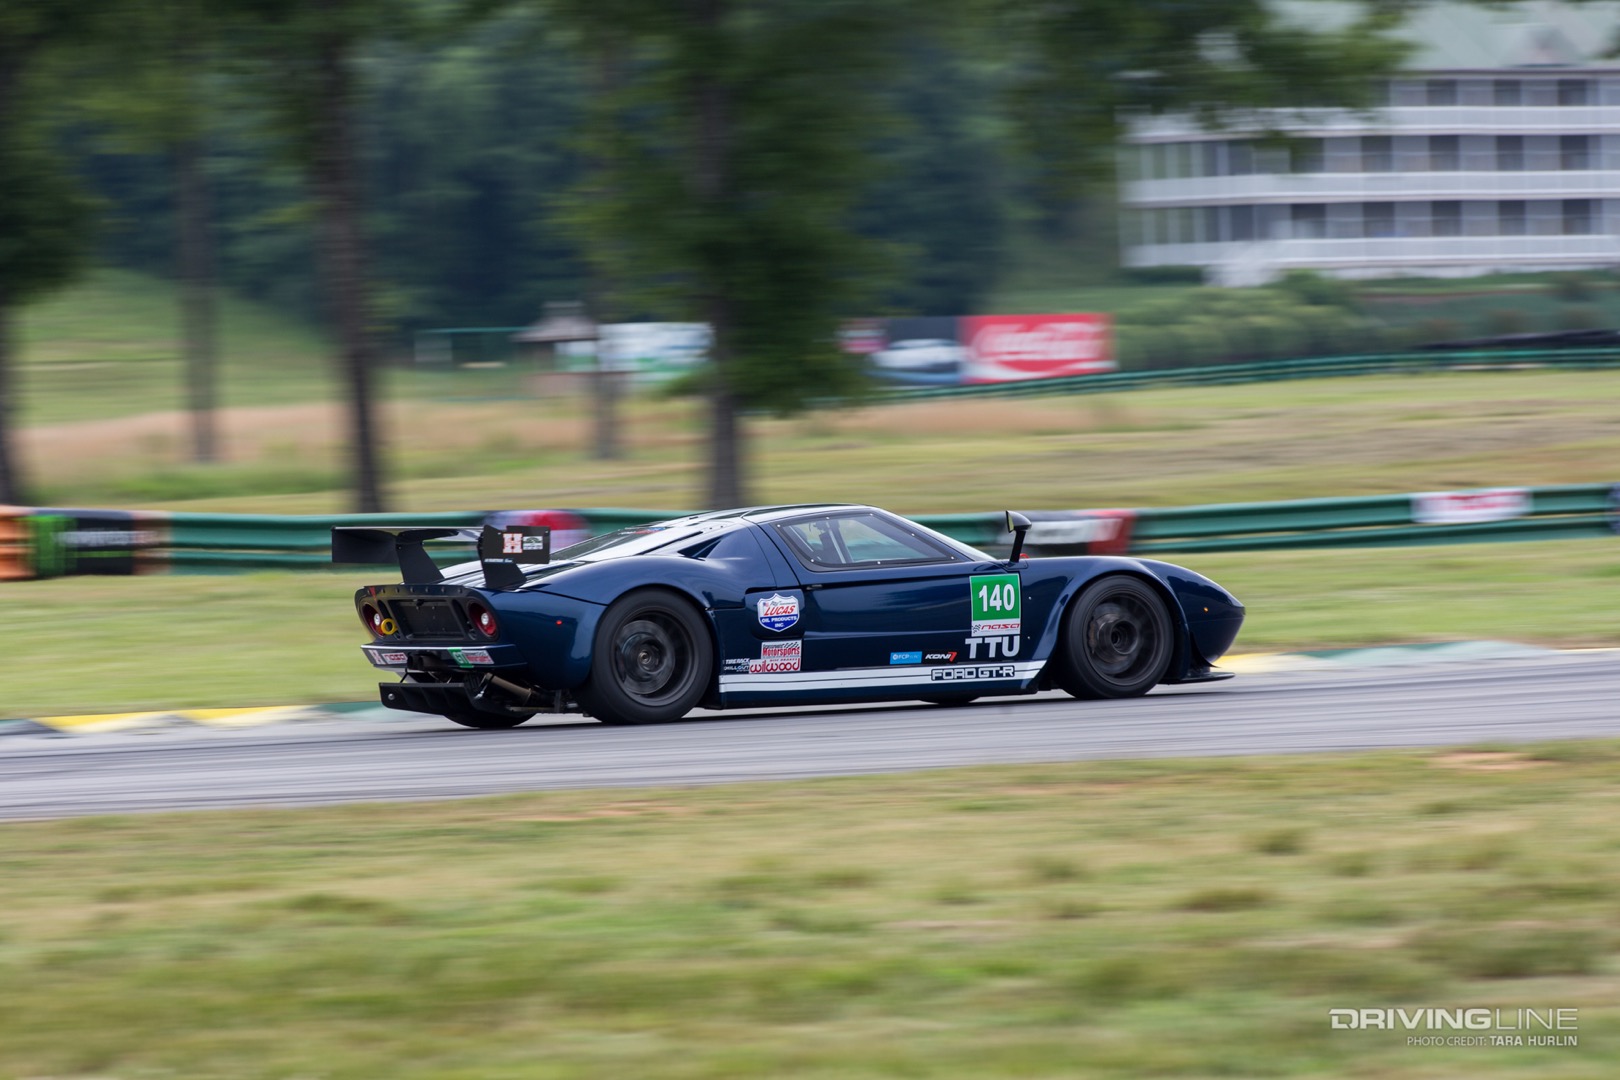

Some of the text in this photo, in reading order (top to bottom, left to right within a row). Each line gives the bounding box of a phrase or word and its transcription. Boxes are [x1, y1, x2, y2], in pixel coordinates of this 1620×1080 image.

[503, 533, 523, 554] H
[978, 584, 1015, 612] 140
[764, 605, 795, 616] LUCAS
[763, 647, 800, 656] Motorsports
[965, 635, 1020, 659] TTU
[750, 658, 801, 673] wilwood
[932, 666, 1015, 680] FORD GT-R
